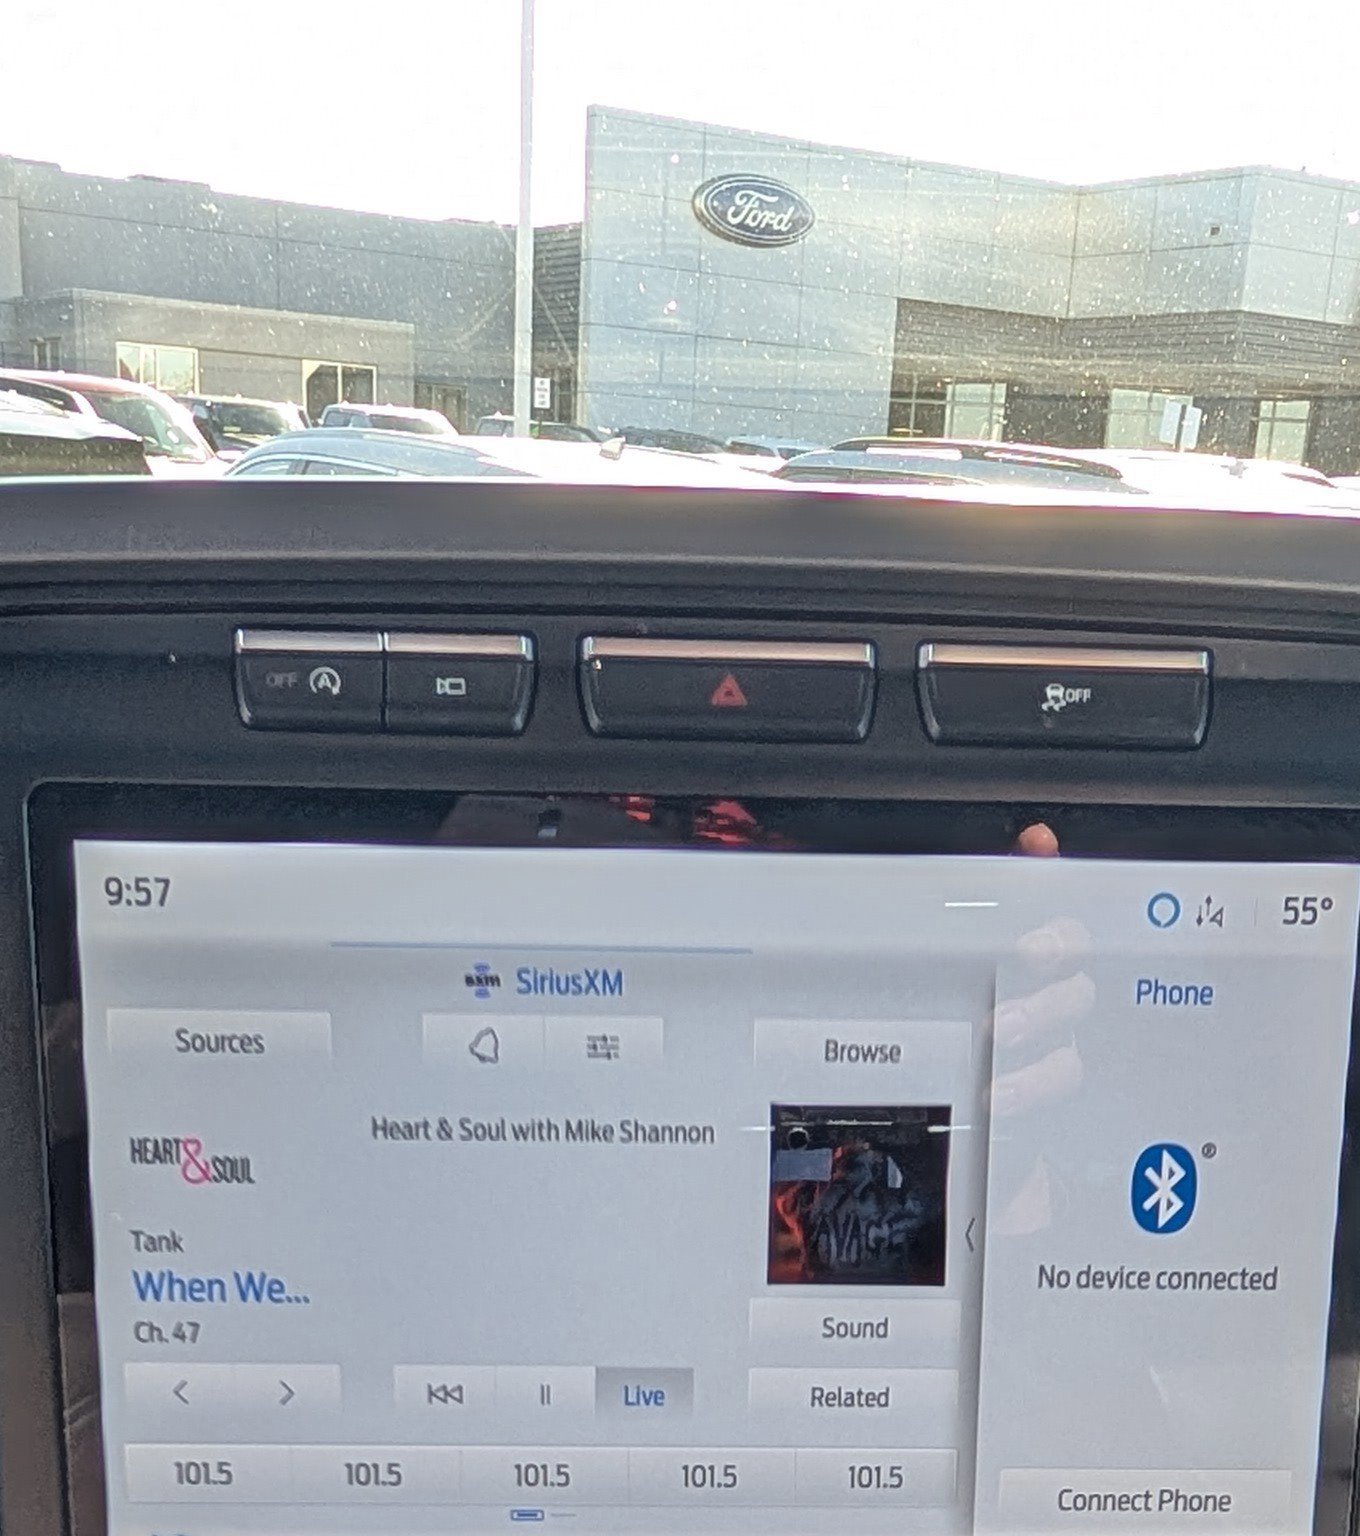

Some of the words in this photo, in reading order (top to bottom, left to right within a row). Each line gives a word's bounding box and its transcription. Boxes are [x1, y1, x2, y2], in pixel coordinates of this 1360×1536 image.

[727, 189, 795, 232] Ford
[1065, 688, 1091, 703] OFF
[104, 876, 171, 908] 9:57
[1282, 896, 1333, 926] 55°
[516, 967, 623, 997] SiriusXM
[1136, 980, 1214, 1007] Phone
[175, 1028, 265, 1055] Sources
[824, 1039, 901, 1065] Browse
[372, 1115, 433, 1142] Heart
[437, 1117, 453, 1142] &
[459, 1117, 507, 1143] Soul
[511, 1118, 560, 1143] with
[565, 1119, 614, 1144] Mike
[619, 1119, 715, 1145] Shannon
[129, 1229, 184, 1253] Tank
[132, 1271, 226, 1303] When
[234, 1272, 310, 1304] We...
[1039, 1265, 1069, 1289] No
[1076, 1265, 1149, 1290] device
[1156, 1266, 1278, 1291] connected
[134, 1321, 168, 1344] Ch.
[173, 1321, 200, 1344] 47
[822, 1317, 889, 1339] Sound
[623, 1384, 665, 1407] Live
[810, 1387, 890, 1409] Related
[174, 1461, 233, 1486] 101.5
[345, 1462, 402, 1487] 101.5
[514, 1463, 570, 1488] 101.5
[682, 1464, 737, 1489] 101.5
[848, 1465, 903, 1490] 101.5
[1058, 1489, 1153, 1513] Connect
[1158, 1489, 1232, 1513] Phone
